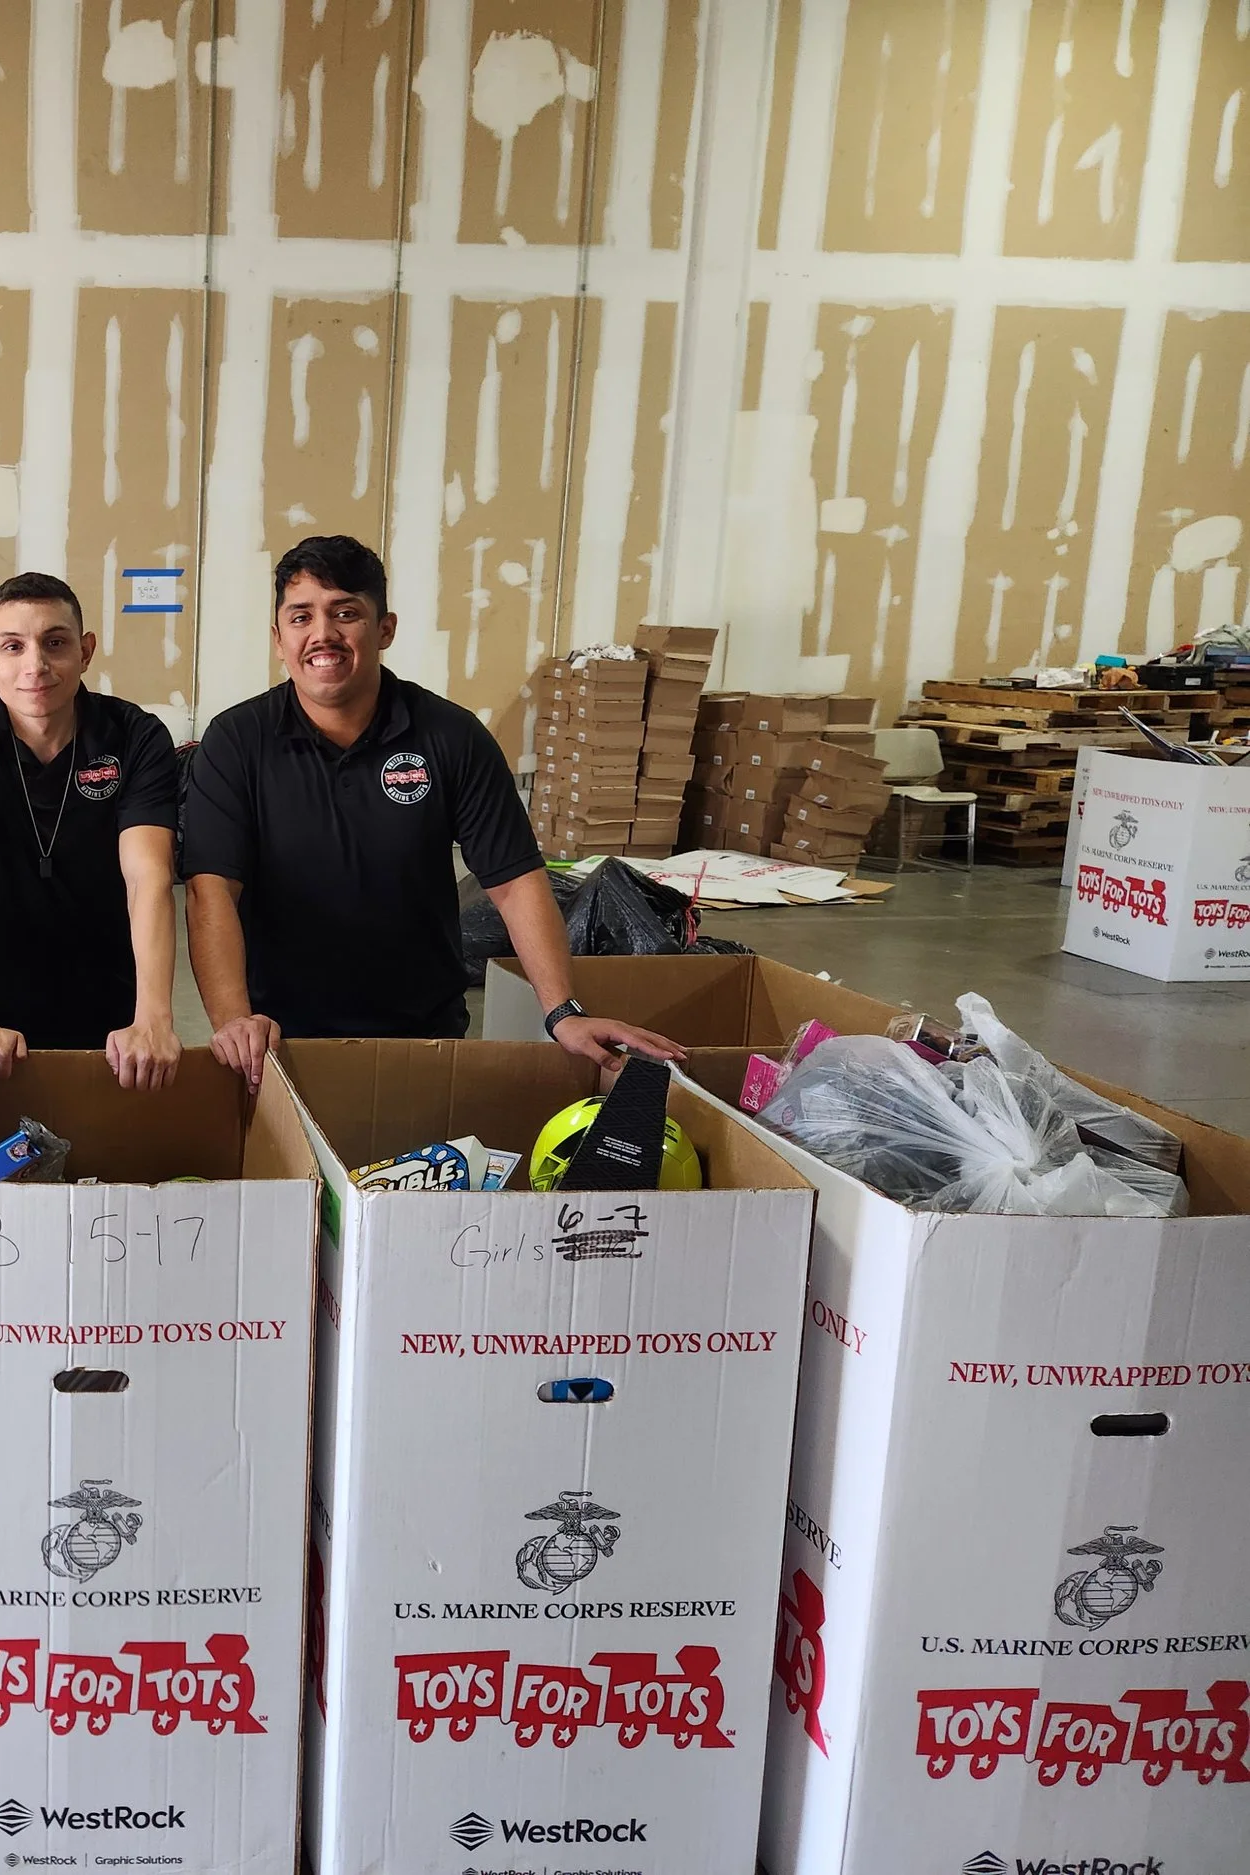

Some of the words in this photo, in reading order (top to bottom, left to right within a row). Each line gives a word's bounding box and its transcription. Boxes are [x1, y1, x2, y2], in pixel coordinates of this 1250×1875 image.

[1080, 871, 1100, 891] TOYS
[1104, 880, 1124, 902] FOR
[1131, 890, 1162, 915] TOTS
[1197, 903, 1225, 918] TOYS
[1230, 906, 1250, 920] FOR
[1218, 949, 1250, 958] WestRo
[744, 1081, 763, 1110] Barbie
[450, 1224, 544, 1269] Girls
[149, 1323, 211, 1342] TOYS
[219, 1321, 286, 1340] ONLY
[810, 1299, 868, 1356] ONLY
[401, 1334, 464, 1357] NEW,
[472, 1335, 631, 1354] UNWRAPPED
[637, 1333, 700, 1353] TOYS
[707, 1332, 777, 1352] ONLY
[949, 1362, 1017, 1387] NEW,
[1027, 1365, 1191, 1386] UNWRAPPED
[788, 1499, 842, 1570] SERVE
[73, 1591, 149, 1607] CORPS
[158, 1588, 261, 1605] RESERVE
[394, 1604, 435, 1618] U.S.
[442, 1604, 538, 1618] MARINE
[545, 1603, 622, 1619] CORPS
[629, 1601, 735, 1617] RESERVE
[922, 1637, 964, 1653] U.S.
[971, 1639, 1073, 1656] MARINE
[1079, 1639, 1158, 1655] CORPS
[50, 1662, 122, 1708] FOR
[145, 1668, 242, 1713] TOTS
[405, 1663, 494, 1711] TOYS
[516, 1674, 594, 1720] FOR
[614, 1680, 710, 1727] TOTS
[927, 1700, 1022, 1747] TOYS
[1044, 1713, 1119, 1759] FOR
[1141, 1716, 1237, 1762] TOTS
[41, 1806, 185, 1829] WestRock
[501, 1819, 647, 1843] WestRock
[22, 1855, 77, 1866] WestRock
[95, 1855, 134, 1868] Graphic
[136, 1854, 182, 1865] Solutions
[1016, 1856, 1164, 1875] WestRock
